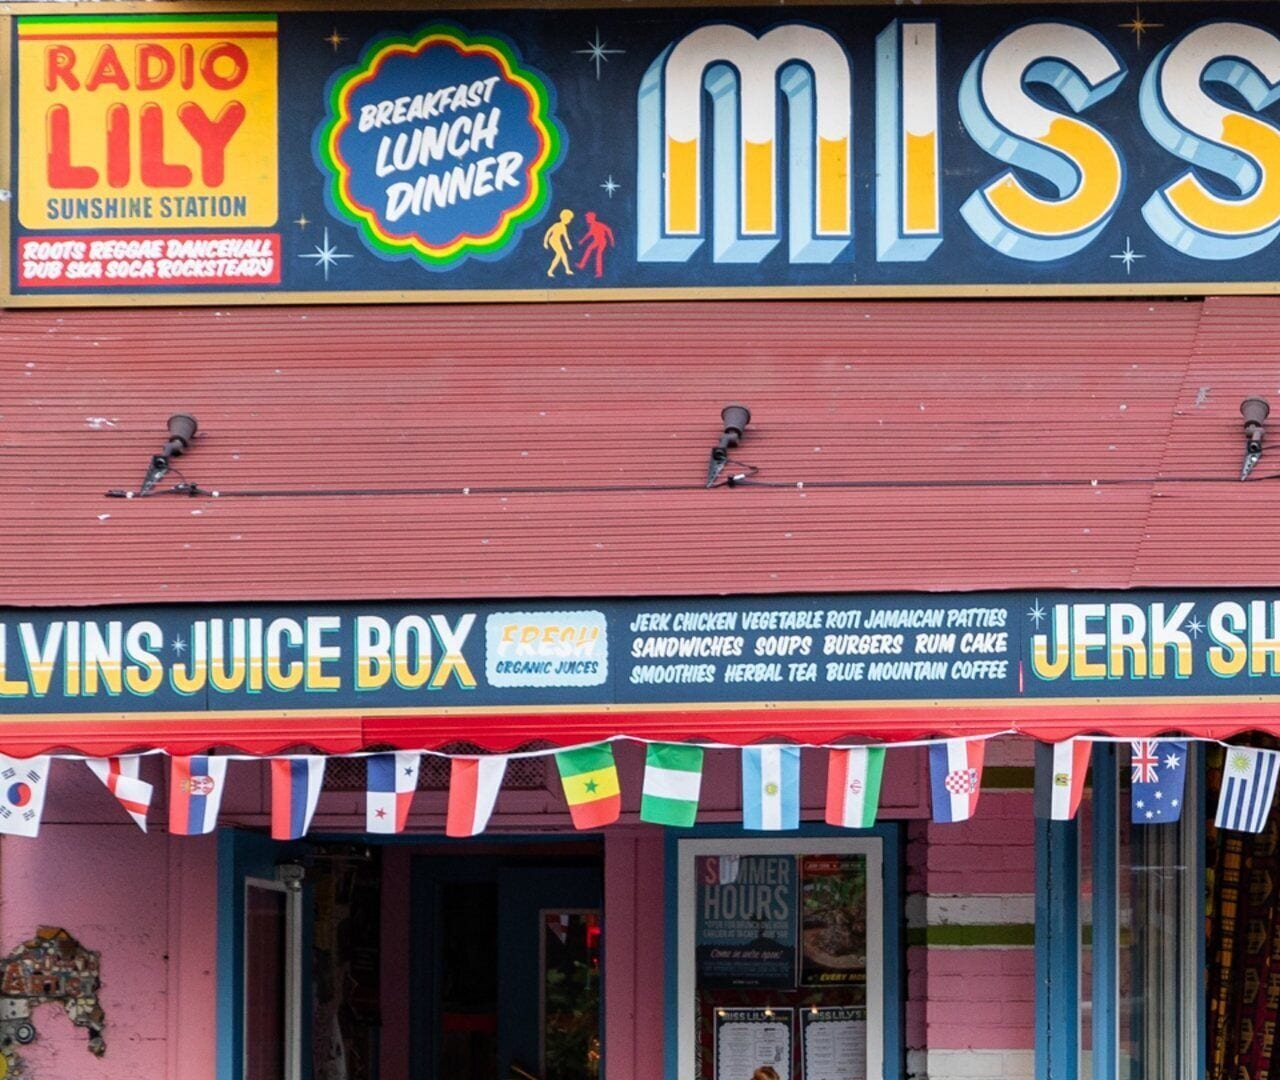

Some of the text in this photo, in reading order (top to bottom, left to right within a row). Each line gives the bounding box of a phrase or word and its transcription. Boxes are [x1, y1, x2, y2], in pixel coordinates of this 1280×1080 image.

[44, 42, 249, 92] RADIO
[358, 76, 500, 133] BREAKFAST
[45, 101, 247, 190] LILY
[375, 107, 501, 178] LUNCH
[385, 151, 524, 222] DINNER
[47, 195, 247, 219] SUNSHINE STATION
[22, 238, 273, 260] ROOTS REGGAE DANCEHALL
[22, 258, 274, 279] DUB SKA SOCA ROCKSTEADY
[630, 608, 1007, 632] JERK CHICKEN VEGETABLE ROTI JAMAICAN PATTIES
[0, 613, 477, 697] LVINS JUICE BOX
[497, 624, 600, 657] FRESH
[631, 632, 1008, 658] SANDWICHES SOUPS BURGERS RUM CAKE
[1030, 602, 1195, 681] JERK
[496, 660, 599, 674] ORGANIC JUICES
[629, 660, 1008, 684] SMOOTHIES HERBAL TEA BLUE MOUNTAIN COFFEE
[704, 885, 789, 920] HOURS
